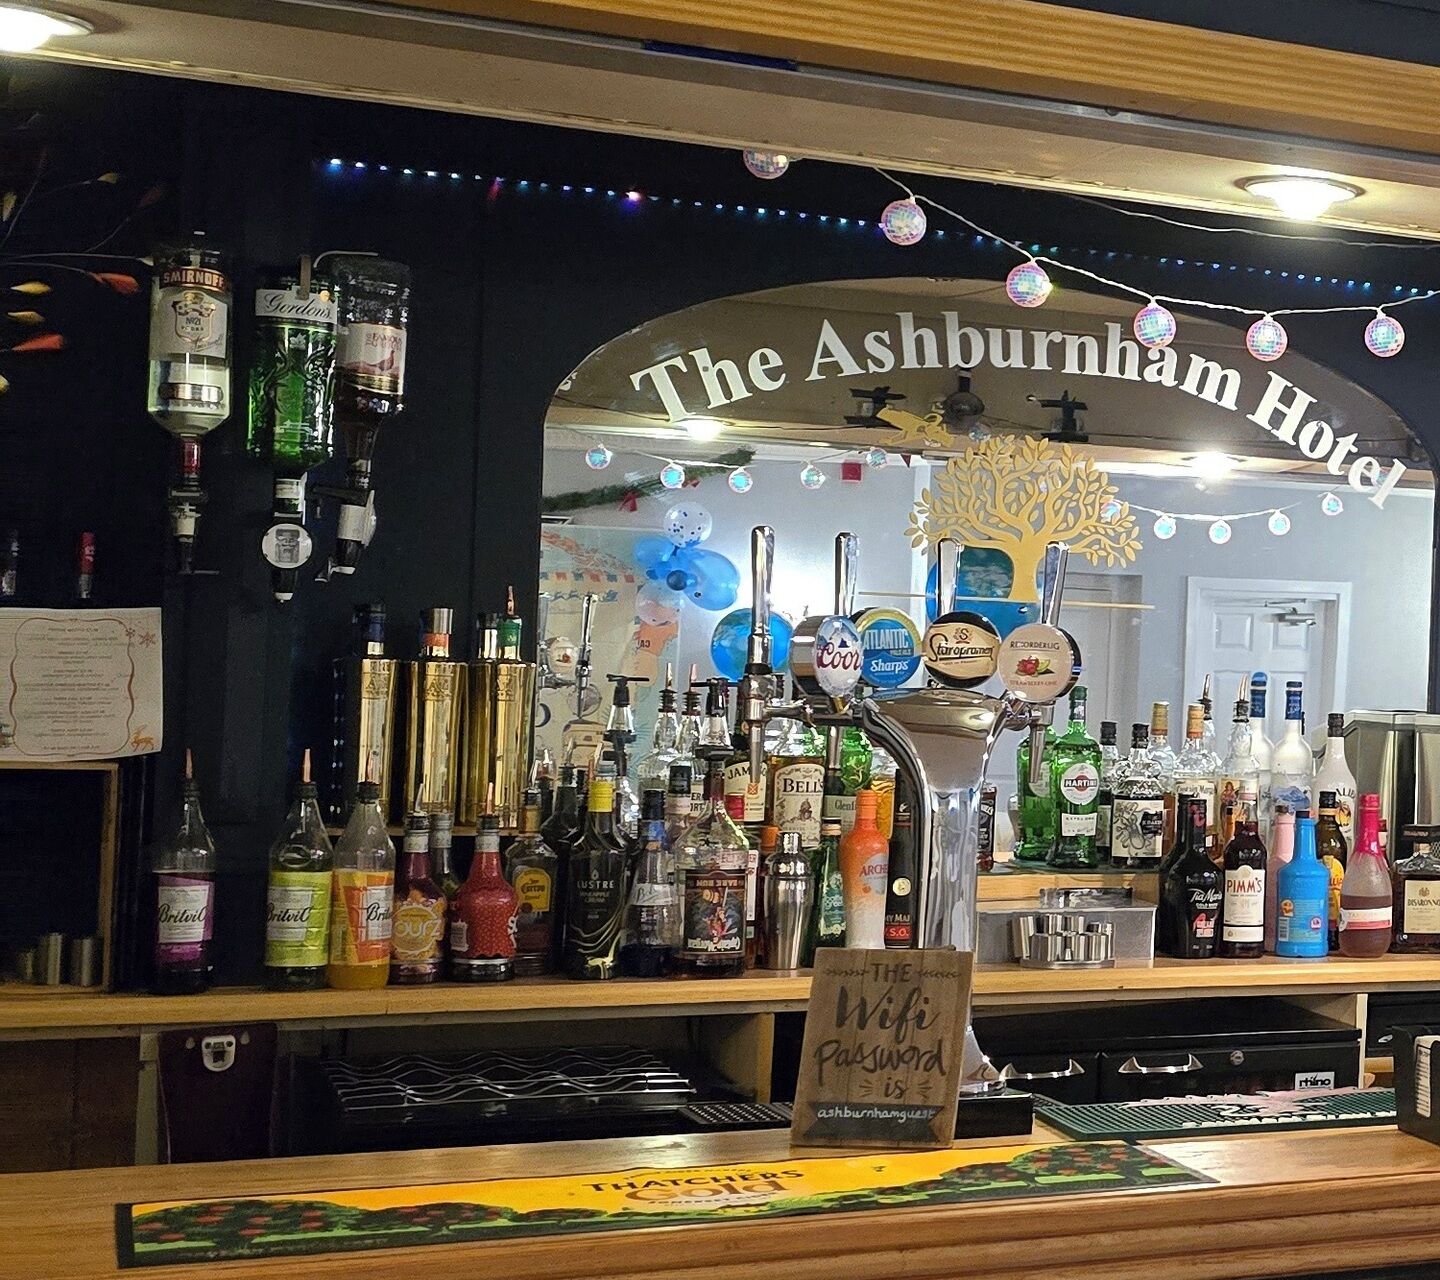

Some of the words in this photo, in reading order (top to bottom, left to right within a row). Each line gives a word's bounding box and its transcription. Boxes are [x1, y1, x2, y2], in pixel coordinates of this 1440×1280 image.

[162, 269, 225, 288] SMIRNOFF
[264, 291, 333, 320] Gordon's
[629, 346, 787, 424] The
[804, 310, 1242, 412] Ashburnham
[1245, 370, 1407, 510] Hotel
[862, 628, 910, 651] ATLANTIC
[928, 632, 996, 663] Staropramen
[869, 658, 910, 674] Sharp's
[782, 777, 825, 794] BELL'S
[576, 880, 615, 889] LUSTRE
[1226, 877, 1263, 894] PIMM'S
[871, 962, 913, 983] THE
[835, 985, 941, 1044] Wifi
[813, 1038, 947, 1087] Password
[884, 1076, 909, 1099] is
[1299, 1077, 1332, 1088] rhino
[817, 1105, 938, 1123] ashburnhamguest
[581, 1169, 805, 1192] THATCHERS
[624, 1179, 788, 1202] Gold
